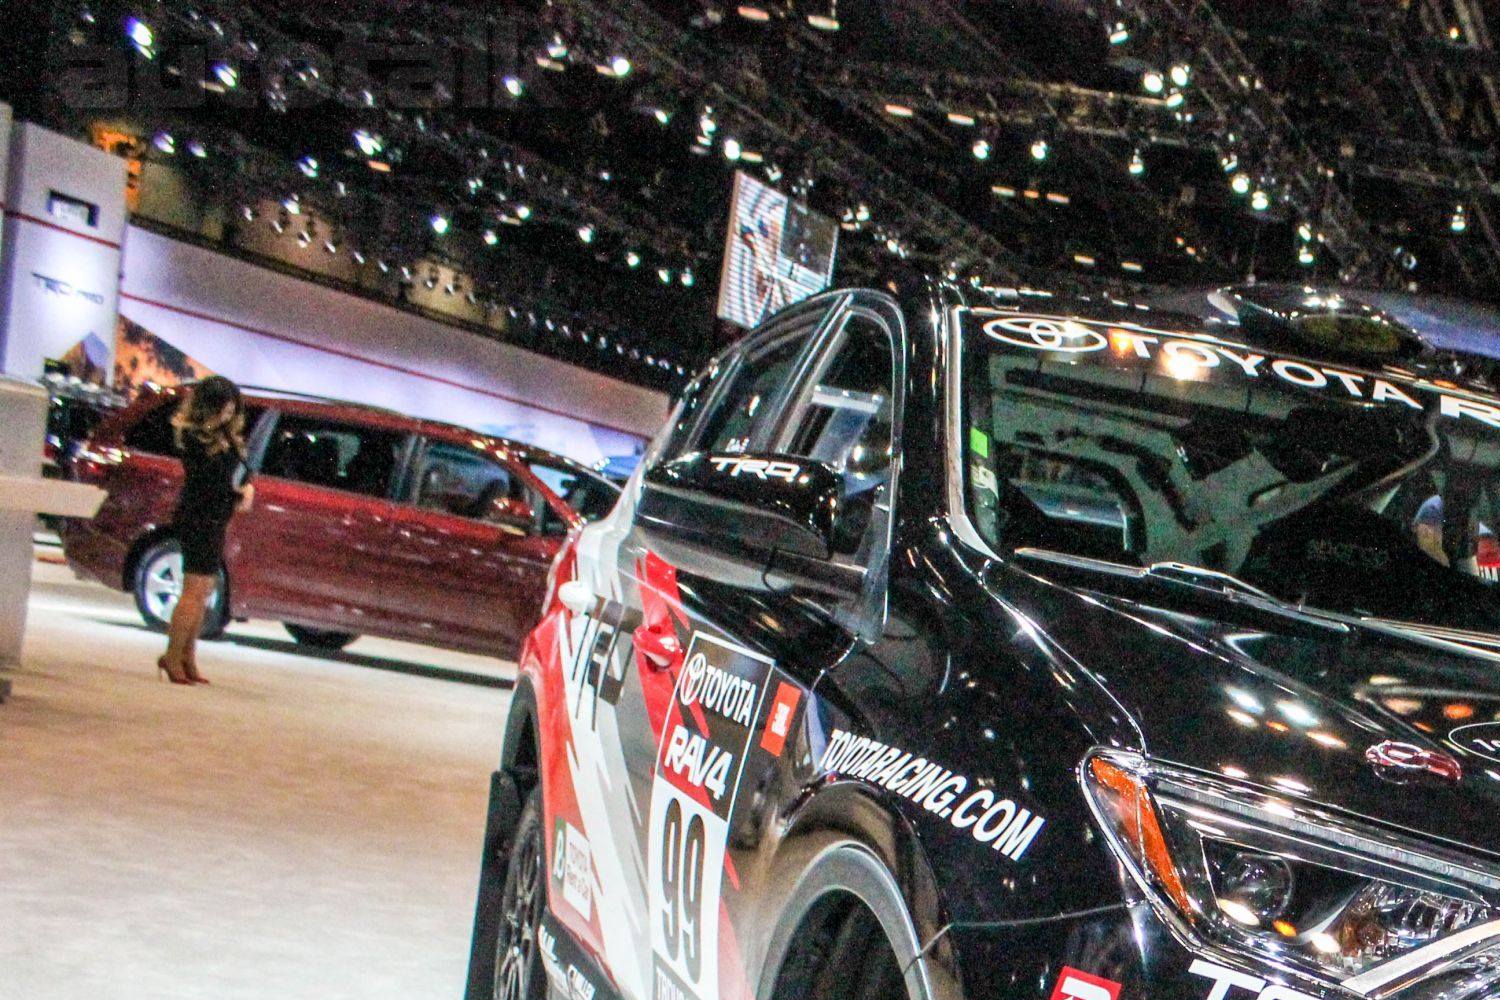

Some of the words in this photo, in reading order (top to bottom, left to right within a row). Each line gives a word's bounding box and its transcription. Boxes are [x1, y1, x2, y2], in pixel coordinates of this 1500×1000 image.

[1121, 333, 1424, 411] TOYOTA
[710, 456, 801, 481] TRD
[699, 664, 757, 728] TOYOTA
[663, 724, 734, 801] RAV4
[818, 728, 1047, 862] TOYOTARACING.COM
[660, 797, 706, 986] 99
